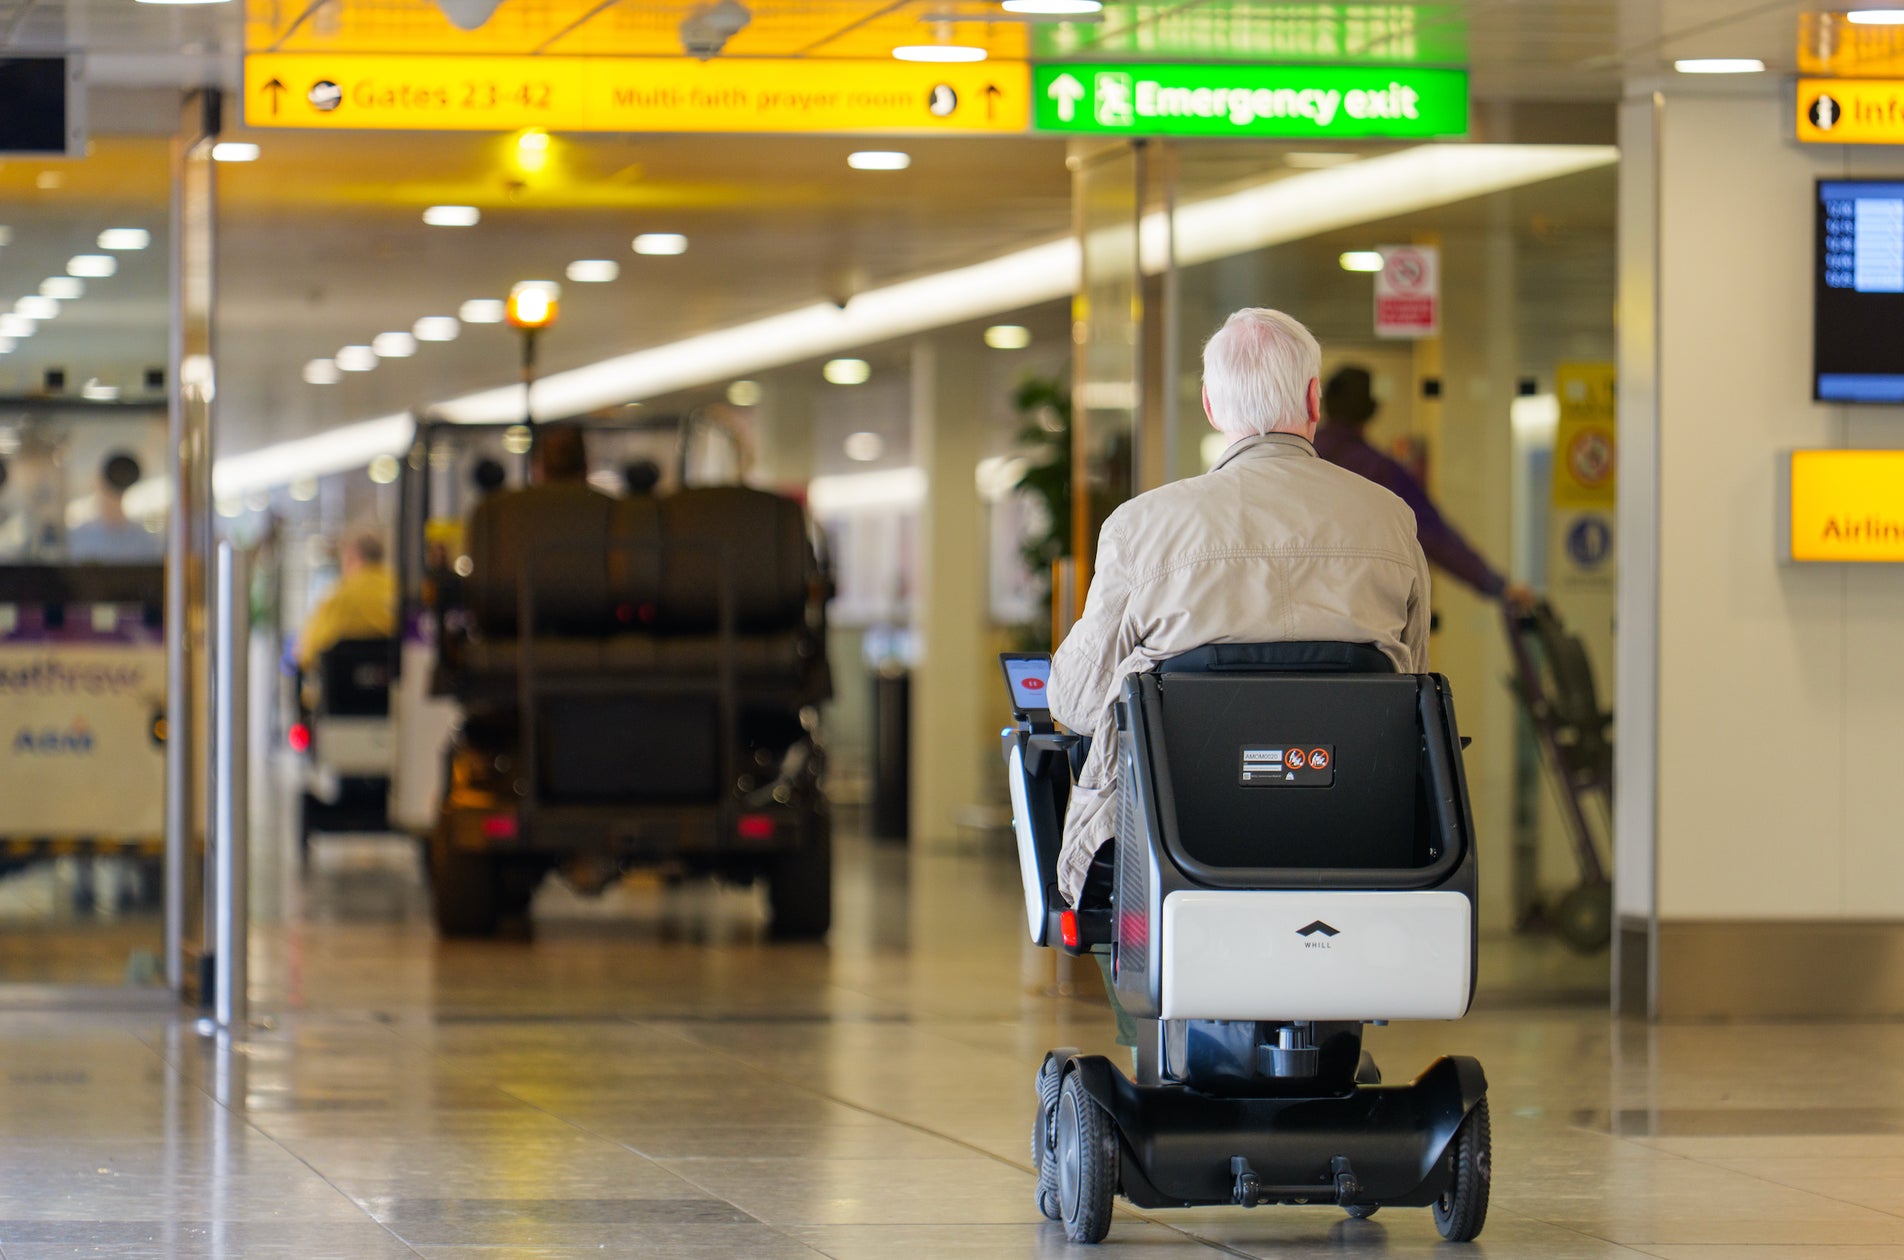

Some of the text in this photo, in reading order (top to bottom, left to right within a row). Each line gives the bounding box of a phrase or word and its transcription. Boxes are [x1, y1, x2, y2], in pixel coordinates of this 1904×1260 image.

[352, 79, 556, 111] Gates 23-42
[612, 84, 914, 116] Multi-faith prayer room
[1135, 80, 1419, 126] Emergency exit
[1853, 96, 1904, 125] Inf
[1821, 514, 1904, 544] Airlin
